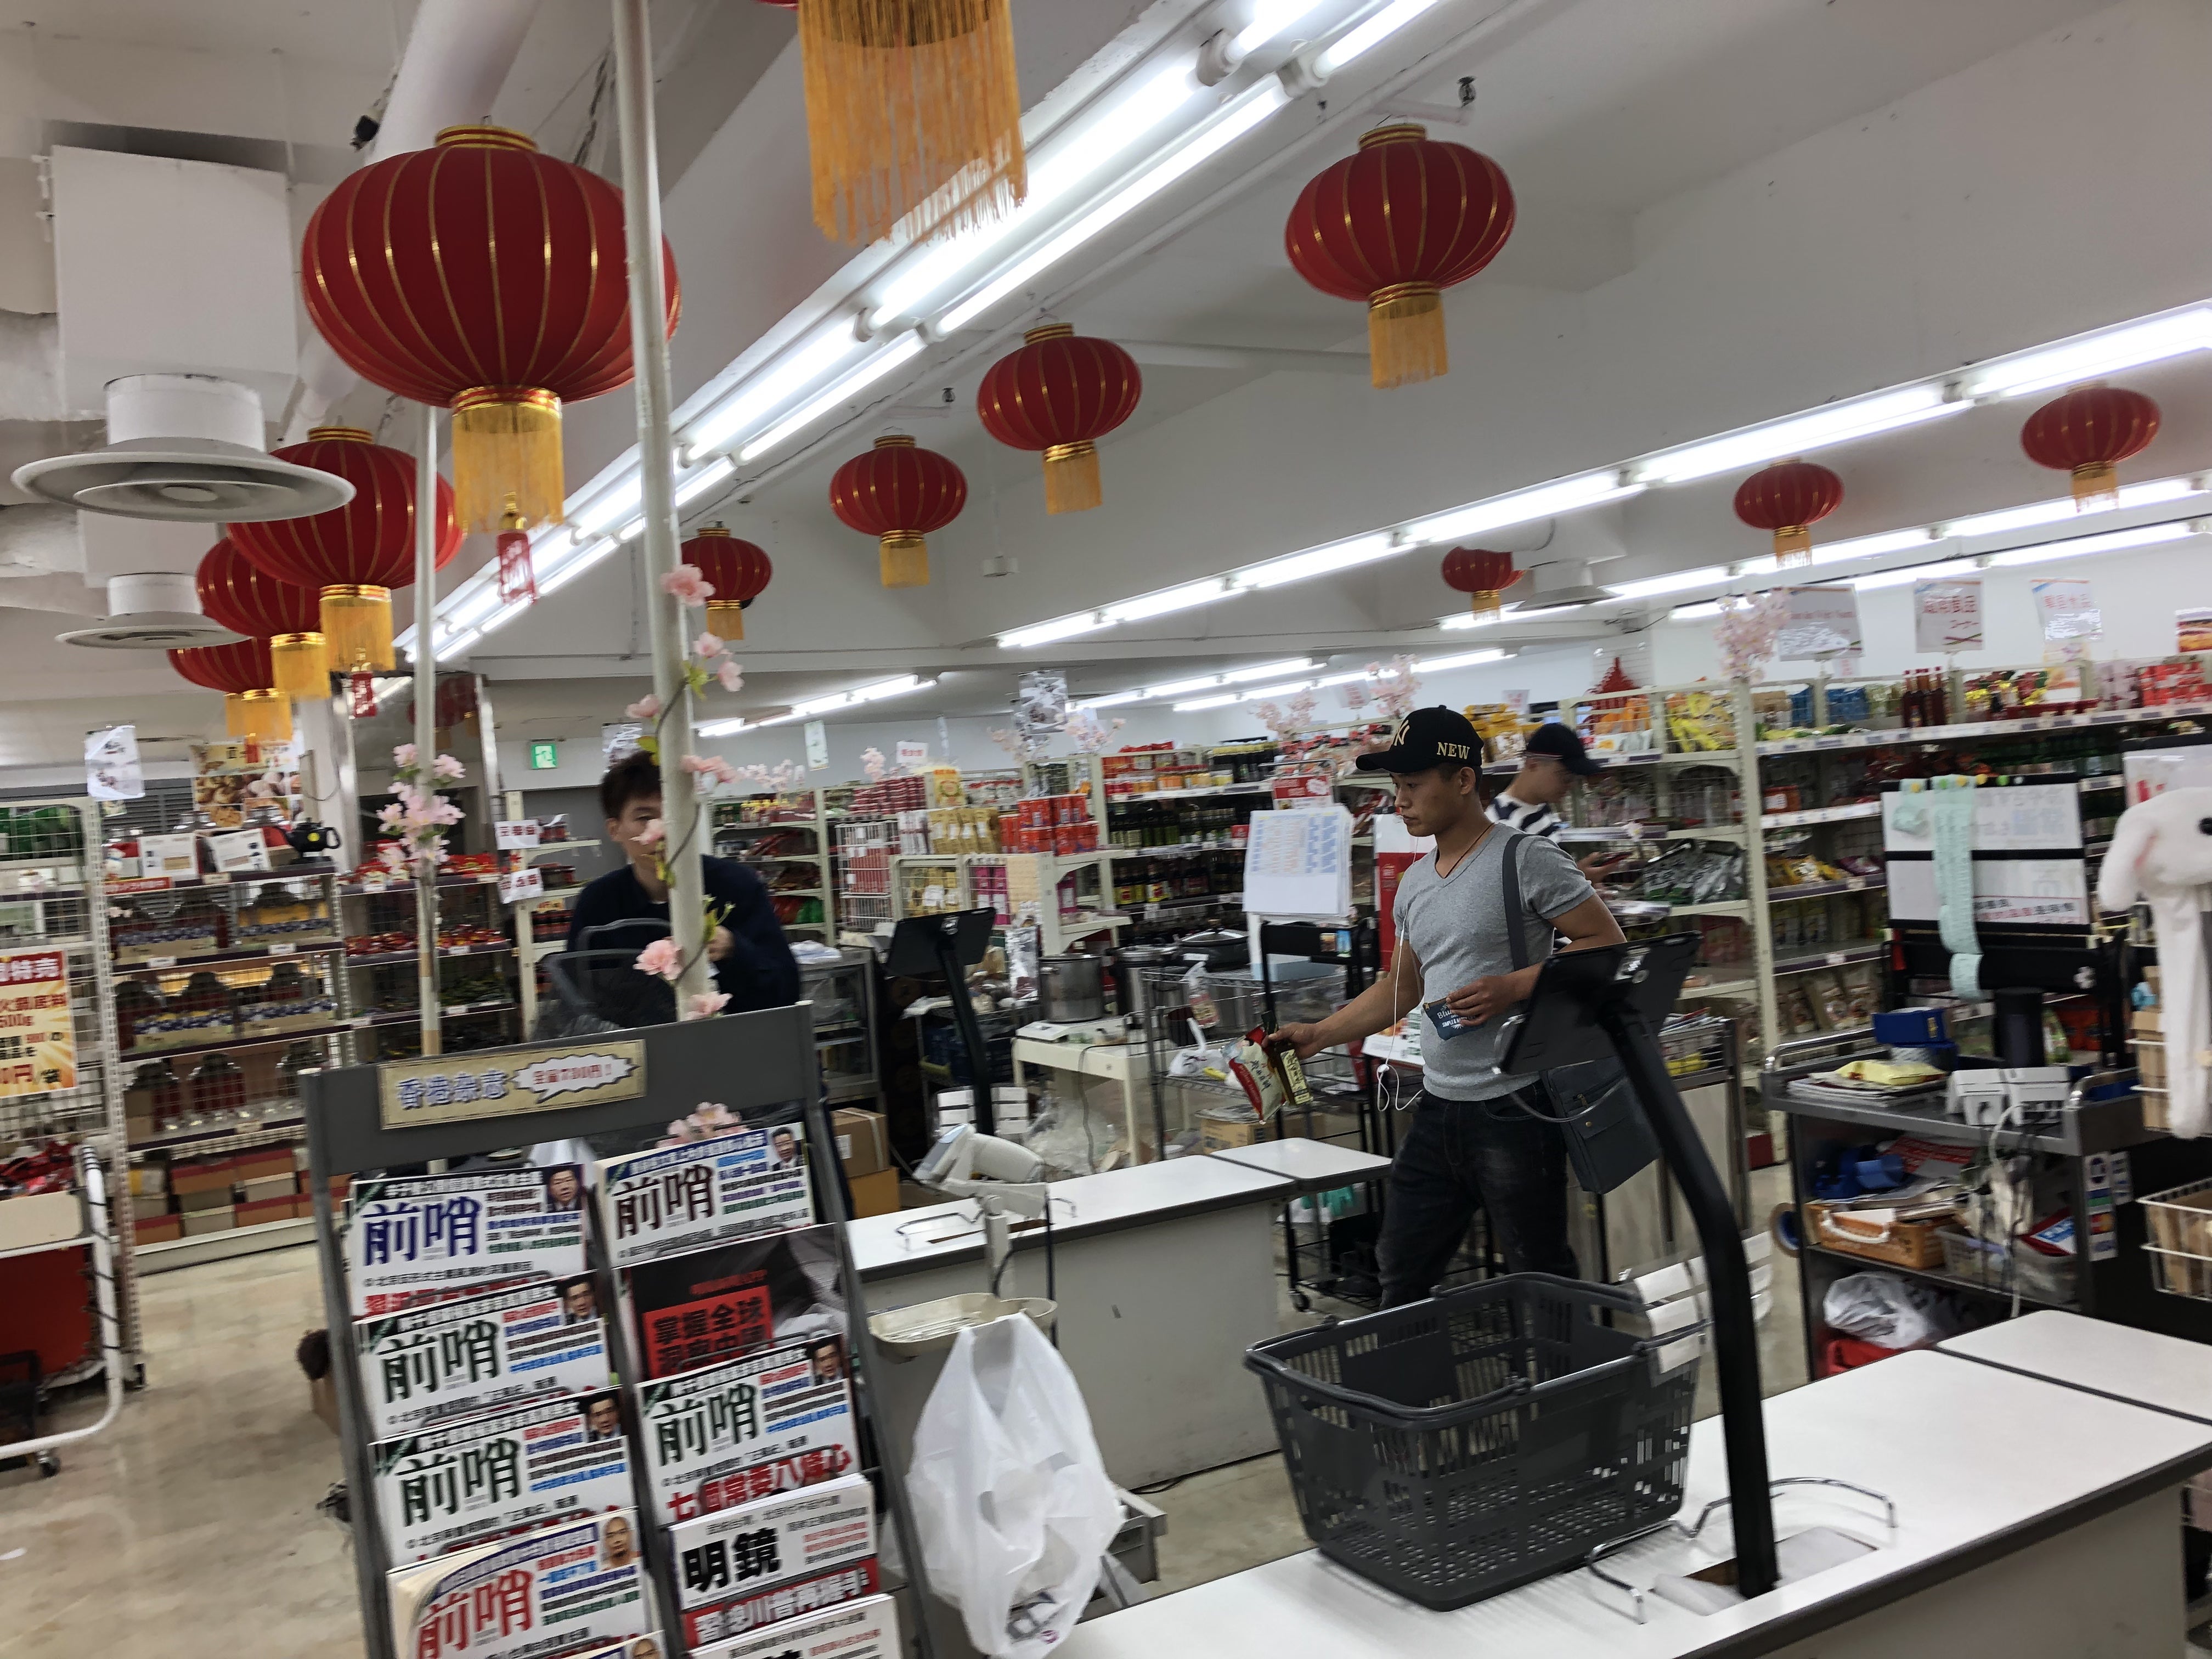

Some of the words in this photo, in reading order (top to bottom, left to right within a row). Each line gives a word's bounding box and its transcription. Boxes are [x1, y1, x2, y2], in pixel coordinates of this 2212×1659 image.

[1436, 742, 1470, 760] NEW
[362, 1196, 482, 1266] 前哨
[612, 1163, 714, 1240] 前哨
[377, 1319, 500, 1403] 前哨
[651, 1383, 758, 1466] 前哨
[395, 1437, 521, 1527] 前哨
[682, 1528, 783, 1592] 明鏡
